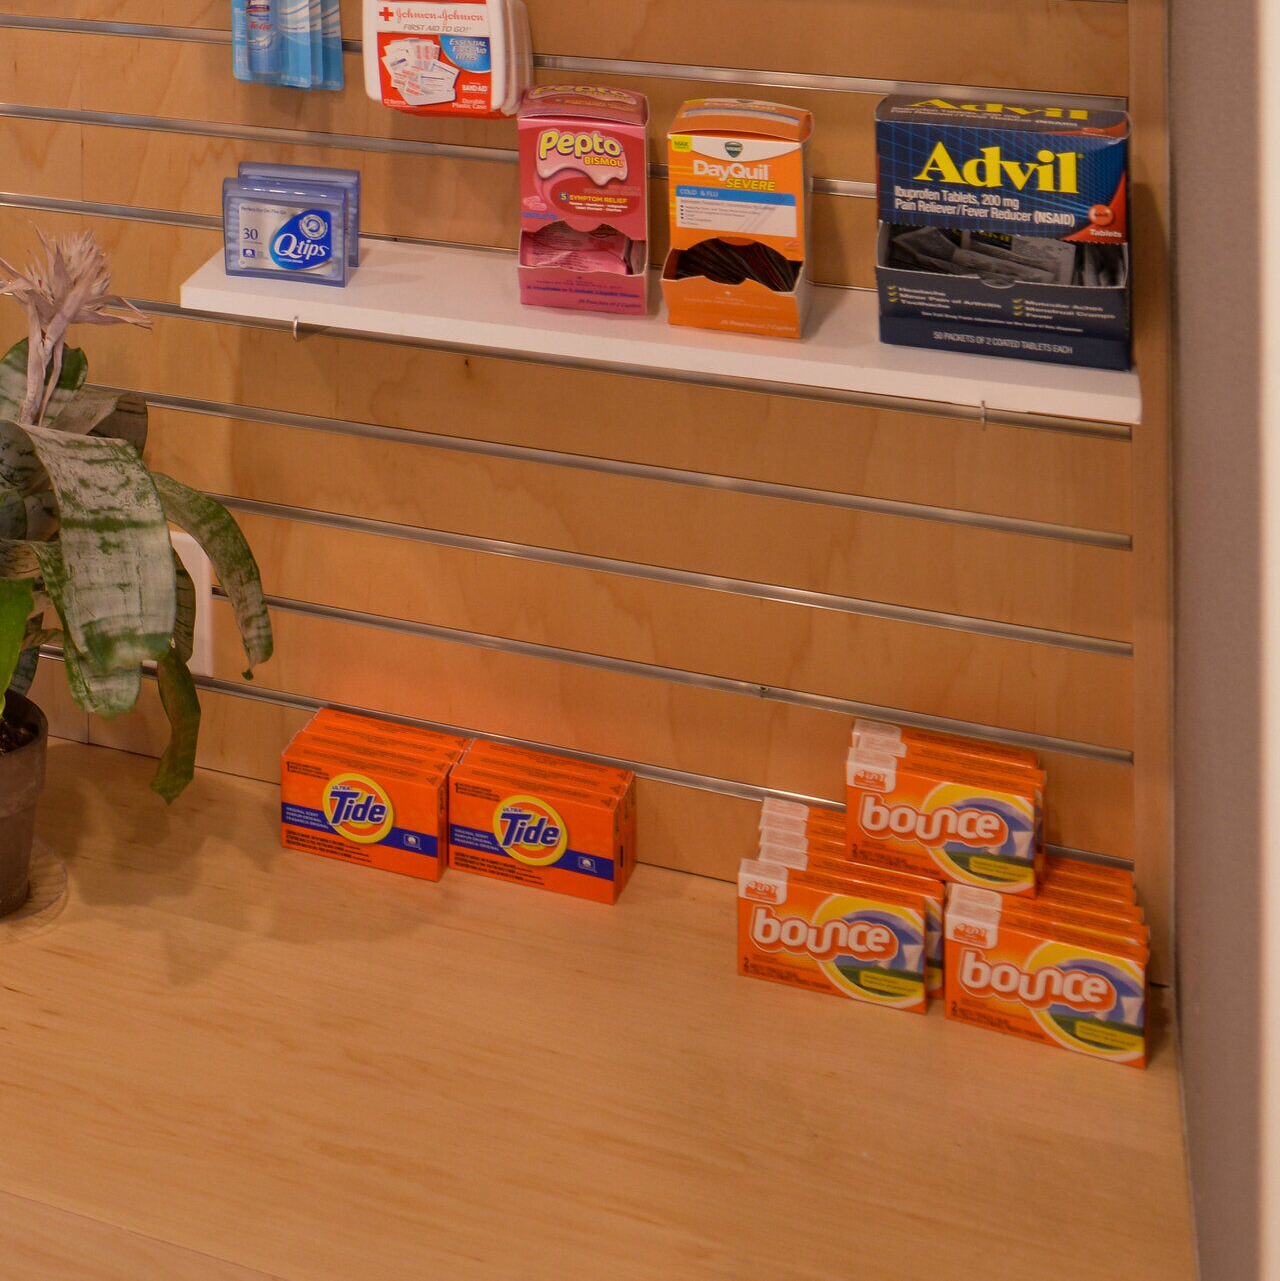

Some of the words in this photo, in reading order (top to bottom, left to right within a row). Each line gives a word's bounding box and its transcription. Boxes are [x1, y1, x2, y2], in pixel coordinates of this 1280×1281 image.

[904, 98, 1090, 121] Advil
[583, 155, 625, 169] BISMOL
[692, 158, 769, 183] DayQuil
[912, 140, 1081, 195] Advil
[679, 188, 698, 197] COLD
[725, 177, 776, 192] SEVERE
[603, 195, 628, 204] RELIEF
[893, 185, 941, 202] Ibuprofen
[941, 189, 981, 207] Tablets,
[981, 194, 1003, 207] 200
[1002, 197, 1021, 211] mg
[893, 198, 917, 212] Pain
[990, 207, 1032, 223] Reducer
[1033, 210, 1077, 228] (NSAID)
[243, 228, 259, 241] 30
[1088, 228, 1123, 239] Tablets
[328, 788, 388, 826] Tide
[860, 793, 1002, 841] bounce
[499, 810, 562, 849] Tide
[753, 906, 892, 955] bounce
[962, 950, 1109, 1004] bounce
